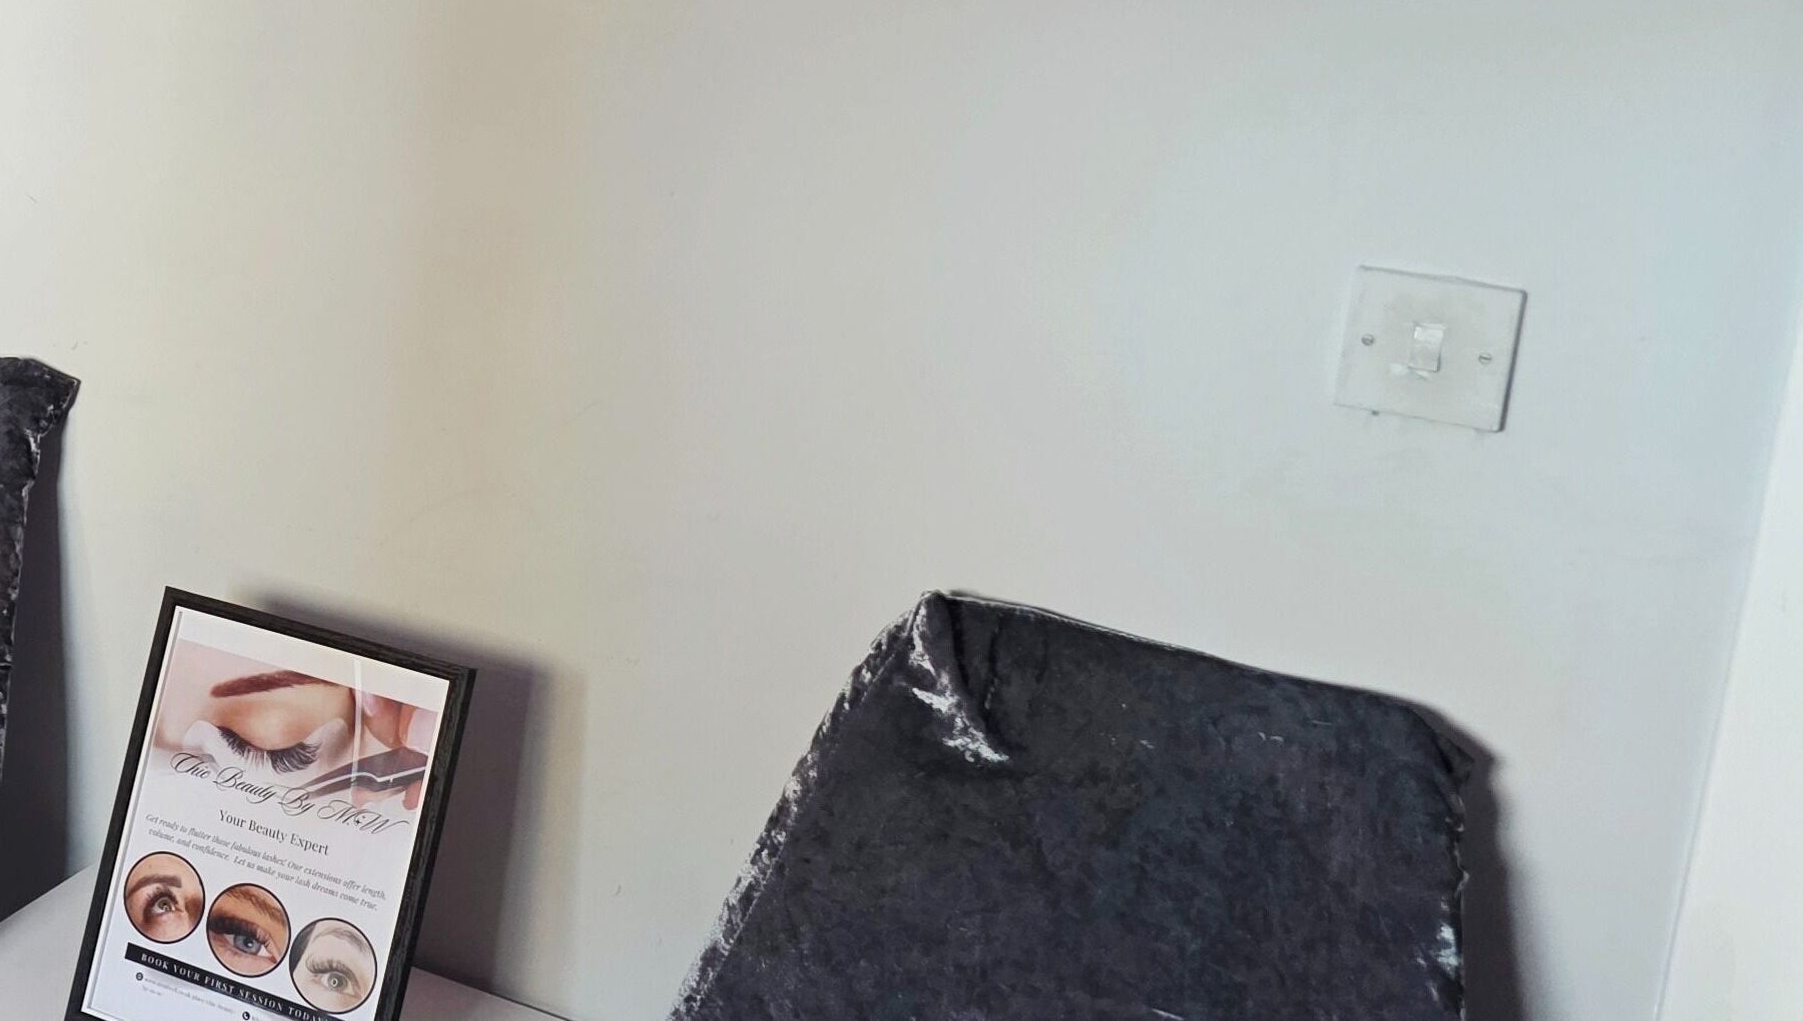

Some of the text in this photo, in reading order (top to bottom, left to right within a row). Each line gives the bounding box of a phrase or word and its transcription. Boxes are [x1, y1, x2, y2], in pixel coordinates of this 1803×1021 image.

[170, 752, 210, 779] Chic
[212, 766, 277, 804] Beauty
[276, 787, 315, 816] By
[145, 814, 159, 825] Get
[159, 818, 179, 831] ready
[179, 825, 188, 834] to
[188, 827, 211, 840] flutter
[230, 841, 261, 858] fabulous
[287, 860, 303, 872] Our
[303, 867, 342, 885] extensions
[342, 879, 360, 891] offer
[219, 809, 330, 855] Your Beauty Expert
[176, 837, 190, 848] and
[233, 855, 245, 867] Let
[246, 860, 256, 870] us
[256, 863, 276, 876] make
[276, 871, 295, 882] your
[295, 876, 311, 889] lash
[311, 882, 339, 898] dreams
[339, 893, 359, 905] come
[140, 952, 170, 971] BOOK
[172, 964, 201, 983] YOUR
[203, 975, 235, 995] FIRST
[237, 987, 284, 1013] SESSION
